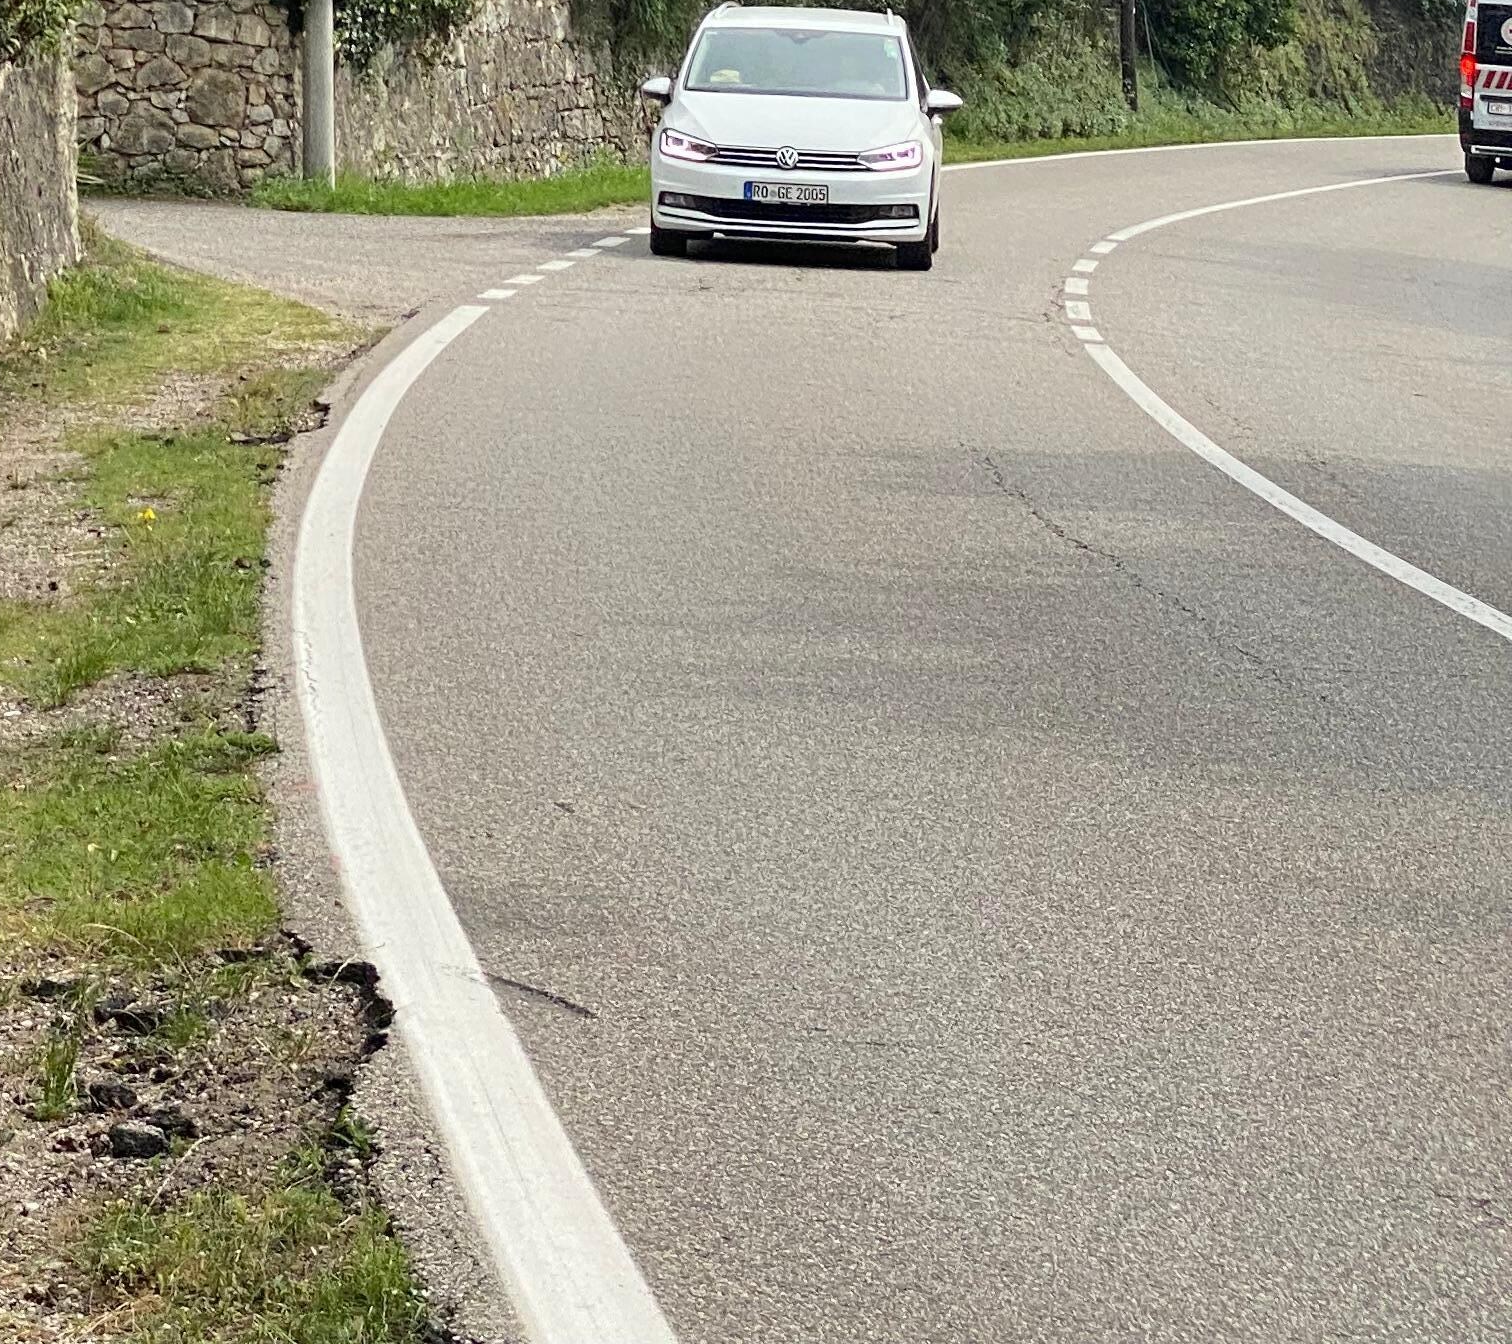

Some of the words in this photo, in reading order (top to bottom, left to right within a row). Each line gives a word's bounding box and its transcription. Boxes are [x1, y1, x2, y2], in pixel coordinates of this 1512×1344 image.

[753, 185, 768, 198] RO
[777, 186, 793, 200] GE
[796, 187, 825, 200] 2005
